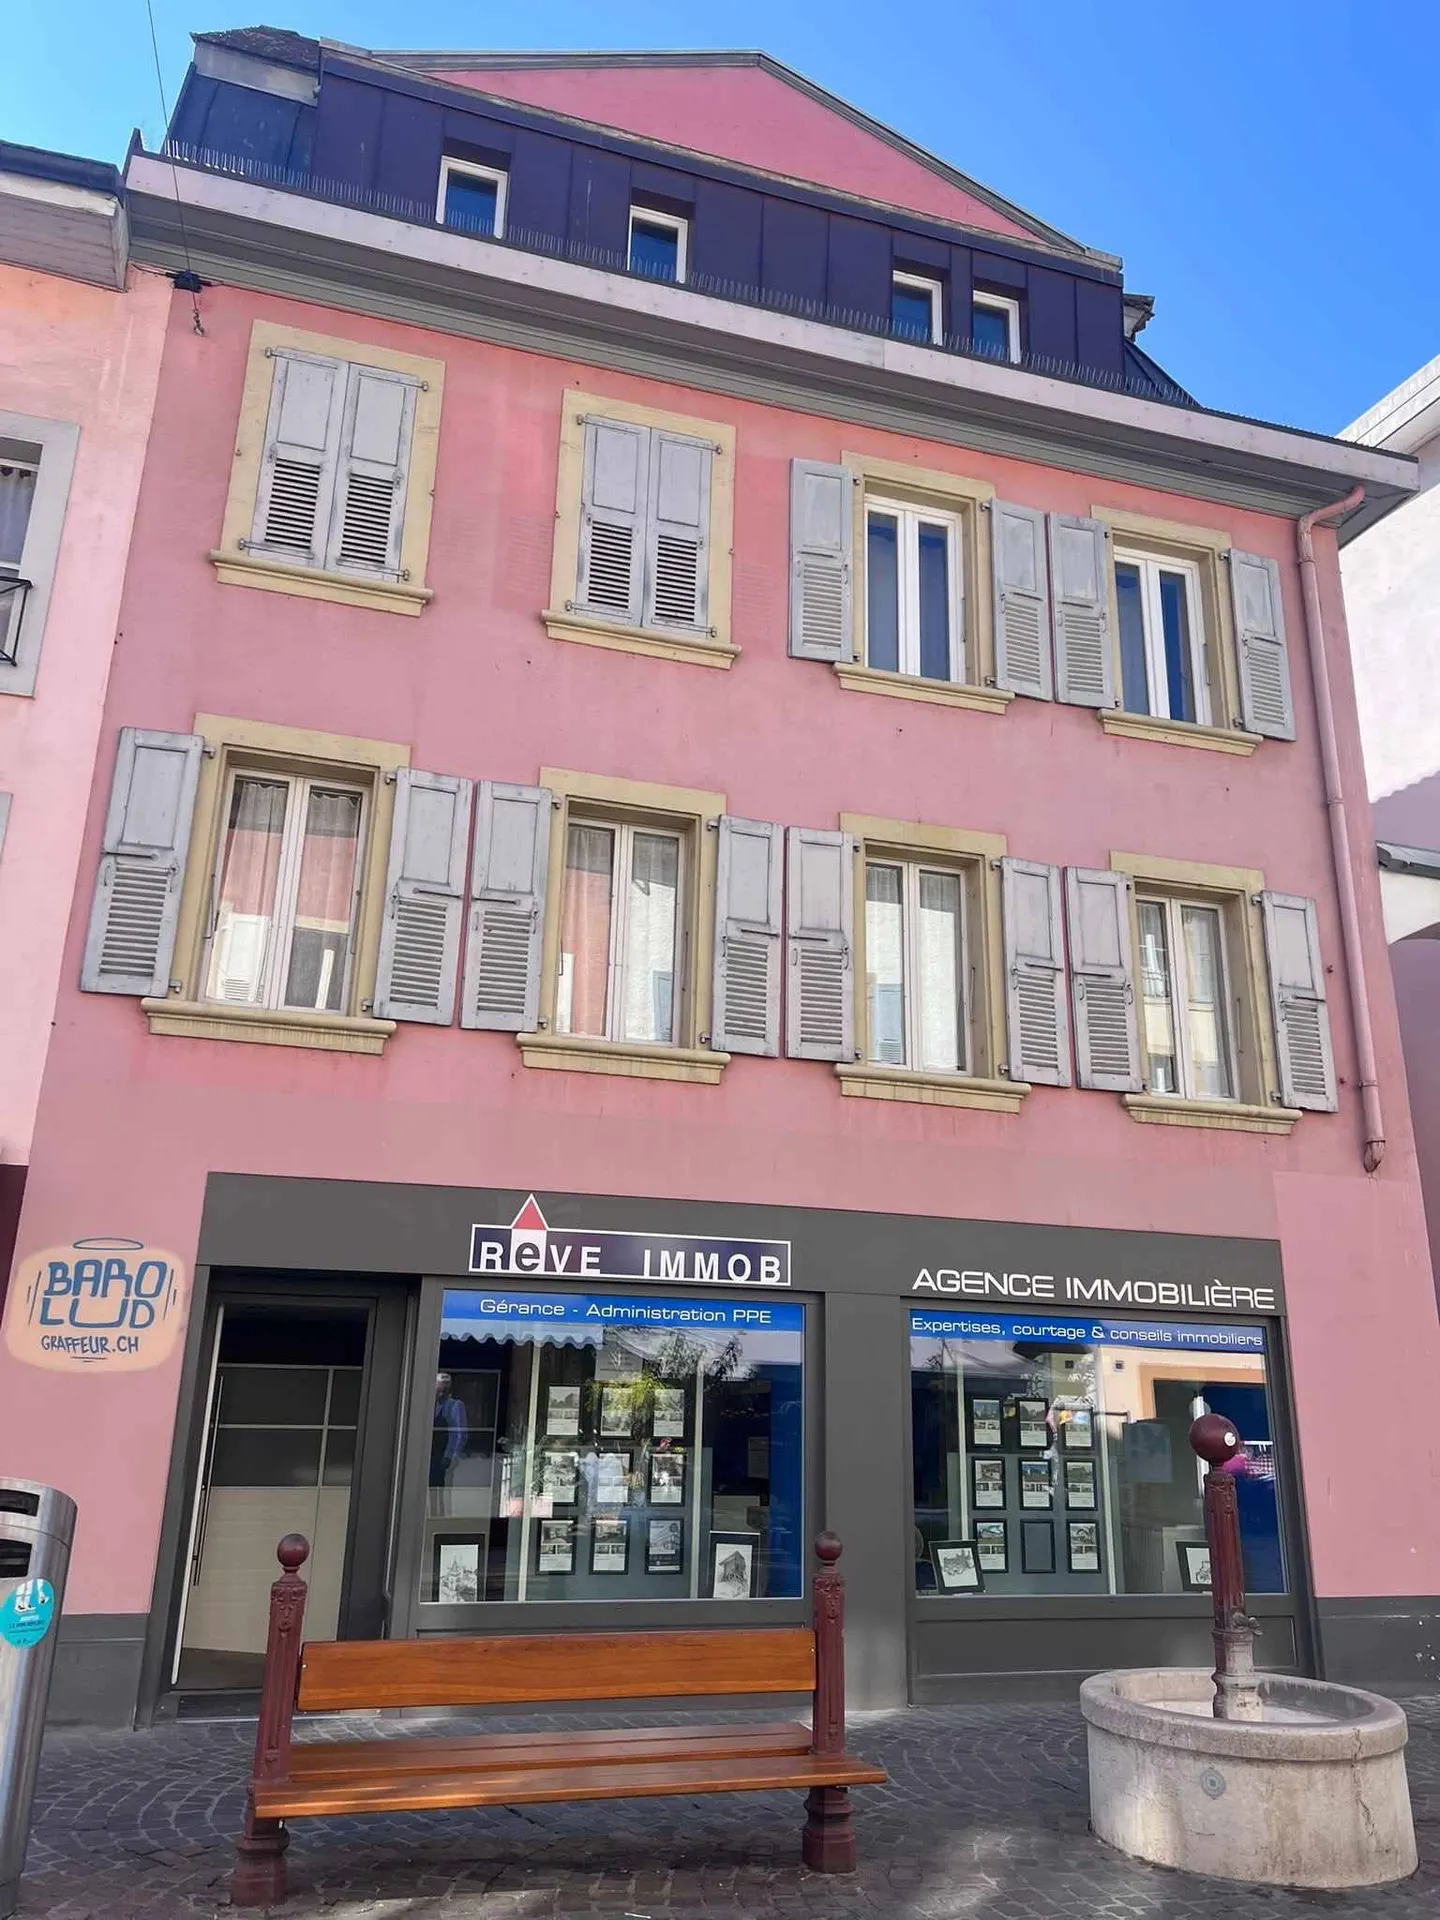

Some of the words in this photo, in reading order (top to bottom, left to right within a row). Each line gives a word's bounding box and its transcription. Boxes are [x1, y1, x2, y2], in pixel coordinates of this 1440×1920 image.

[44, 1258, 168, 1298] BARO
[644, 1249, 781, 1284] IMMOB
[912, 1268, 1055, 1298] AGENCE
[1065, 1276, 1275, 1310] IMMOBILIÈRE
[39, 1297, 156, 1330] LUD
[480, 1299, 565, 1317] Gérance
[586, 1303, 726, 1322] Administration
[733, 1309, 772, 1324] PPE
[41, 1335, 140, 1354] GRAFFEUR.CH
[911, 1317, 1006, 1335] Expertises,
[1012, 1325, 1086, 1341] courtage
[1091, 1327, 1105, 1339] &
[1110, 1329, 1173, 1343] conseils
[1177, 1330, 1263, 1347] immobiliers
